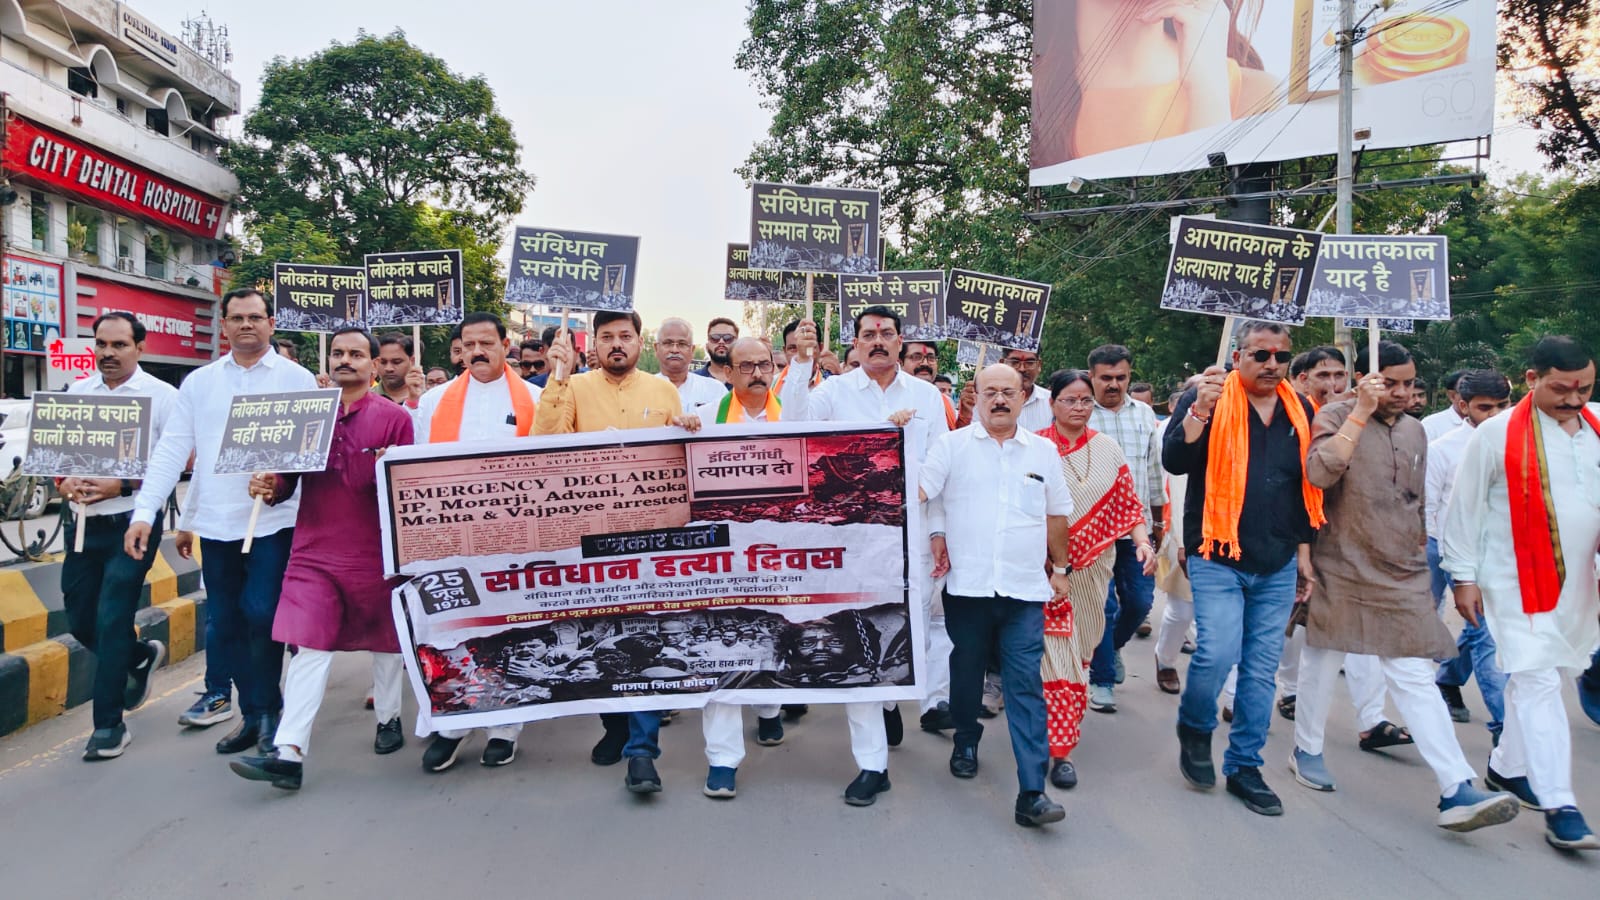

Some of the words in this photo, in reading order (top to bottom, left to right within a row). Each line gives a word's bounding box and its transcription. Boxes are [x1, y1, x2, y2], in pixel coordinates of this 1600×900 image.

[30, 136, 77, 177] CITY
[78, 155, 137, 202] DENTAL
[143, 180, 201, 224] HOSPITAL
[758, 188, 836, 218] संविधान
[840, 199, 870, 220] का
[758, 219, 808, 243] सम्मान
[811, 219, 842, 245] करो
[520, 231, 608, 259] संविधान
[1184, 227, 1288, 260] आपातकाल
[1291, 233, 1314, 261] के
[369, 258, 416, 278] लोकतंत्र
[418, 255, 453, 276] बचाने
[520, 257, 604, 282] सर्वोपरि
[728, 267, 762, 281] अत्याचार
[764, 271, 779, 284] याद
[1173, 256, 1233, 282] अत्याचार
[1235, 266, 1264, 289] याद
[1323, 269, 1368, 292] याद
[1371, 261, 1393, 292] है
[278, 268, 328, 289] लोकतंत्र
[331, 270, 367, 291] हमारी
[370, 282, 393, 299] वालों
[395, 283, 410, 299] को
[411, 283, 435, 299] नमन
[844, 276, 884, 297] संघर्ष
[886, 276, 904, 296] से
[907, 280, 940, 296] बचा
[954, 274, 1044, 305] आपातकाल
[289, 290, 335, 309] पहचान
[961, 300, 991, 325] याद
[994, 300, 1008, 326] है
[165, 317, 193, 338] STORE
[36, 397, 94, 422] लोकतंत्र
[98, 400, 142, 424] बचाने
[232, 397, 271, 418] लोकतंत्र
[273, 398, 290, 415] का
[292, 397, 334, 415] अपमान
[33, 424, 63, 445] वालों
[67, 427, 85, 446] को
[86, 430, 117, 447] नमन
[232, 420, 258, 444] नहीं
[260, 420, 296, 443] सहेंगे
[480, 461, 538, 470] SPECIAL
[546, 454, 638, 465] SUPPLEMENT
[708, 451, 747, 463] इंदिरा
[750, 448, 783, 460] गांधी
[698, 464, 768, 478] त्यागपत्र
[771, 460, 795, 475] दो
[398, 478, 548, 501] EMERGENCY
[564, 467, 687, 487] DECLARED
[398, 502, 431, 514] JP,
[440, 493, 536, 511] Morarji,
[544, 487, 625, 502] Advani,
[632, 482, 687, 495] Asoka
[400, 513, 474, 527] Mehta
[483, 511, 498, 520] &
[505, 502, 605, 519] Vajpayee
[612, 494, 689, 509] arrested
[481, 558, 641, 593] संविधान
[651, 551, 734, 577] हत्या
[744, 543, 846, 571] दिवस
[421, 571, 463, 591] 25
[524, 590, 572, 600] संविधान
[575, 586, 592, 595] की
[635, 582, 655, 590] और
[676, 588, 692, 597] को
[430, 587, 464, 600] जून
[433, 598, 471, 611] 1975
[506, 613, 543, 622] दिनांक
[568, 609, 588, 618] जून
[591, 606, 623, 615] 2026,
[719, 657, 753, 668] हाय-हाय
[612, 681, 648, 692] भाजपा
[651, 678, 680, 690] जिला
[684, 676, 719, 689] कोरबा
